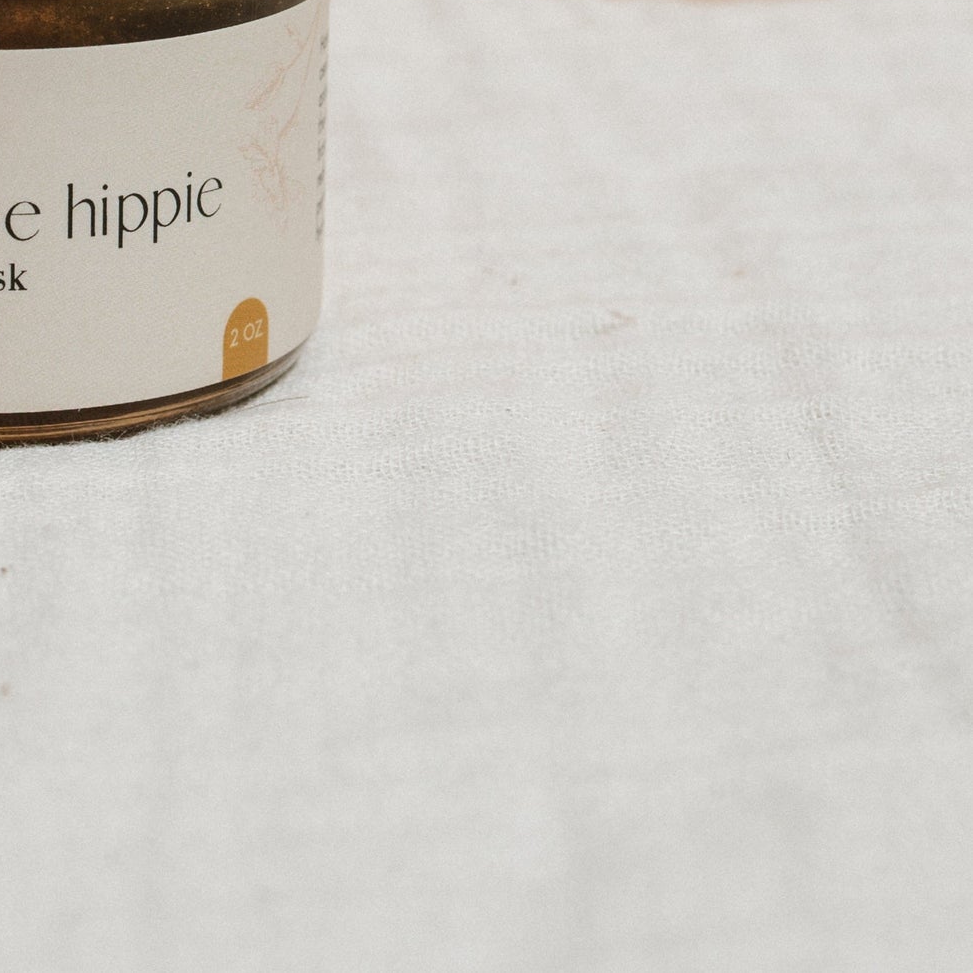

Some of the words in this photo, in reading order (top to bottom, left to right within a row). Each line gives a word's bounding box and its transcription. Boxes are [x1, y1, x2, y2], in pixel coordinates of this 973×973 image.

[66, 171, 224, 249] hippie
[229, 327, 239, 348] 2
[242, 318, 264, 342] OZ
